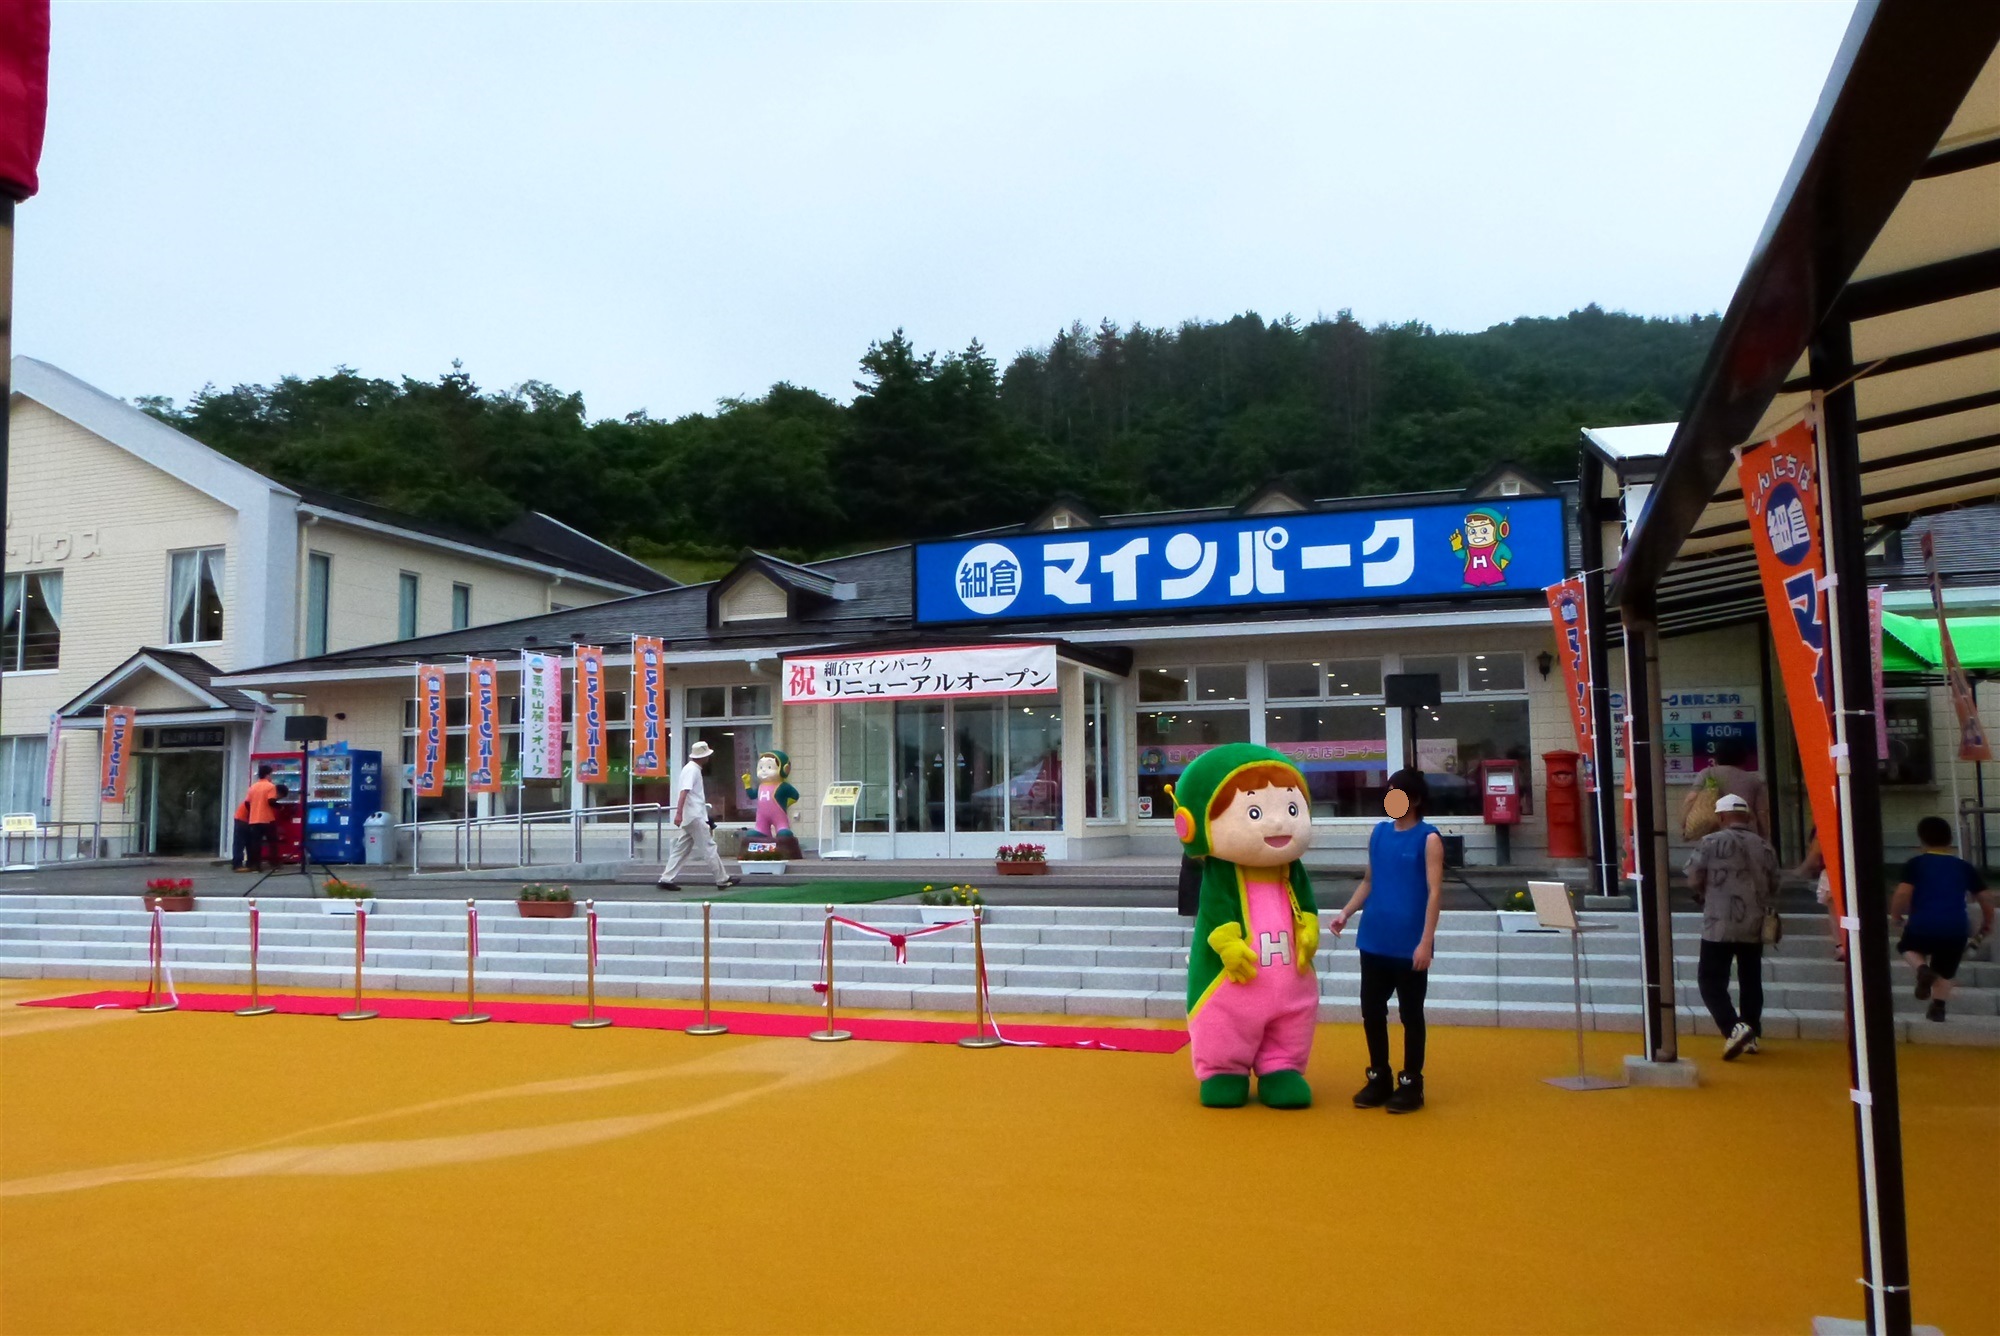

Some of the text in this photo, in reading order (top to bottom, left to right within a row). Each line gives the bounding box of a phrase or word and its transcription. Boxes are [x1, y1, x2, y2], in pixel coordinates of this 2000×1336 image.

[1751, 453, 1812, 516] こんにちは
[1767, 497, 1811, 555] 細倉
[959, 518, 1415, 604] 細倉 マインパーク
[1472, 555, 1487, 569] H
[789, 665, 816, 697] 祝
[824, 656, 933, 677] 細倉マインパーク
[825, 667, 1052, 698] リニューアルオープン
[1706, 725, 1742, 737] 460円
[760, 790, 770, 801] H
[1259, 930, 1291, 967] H
